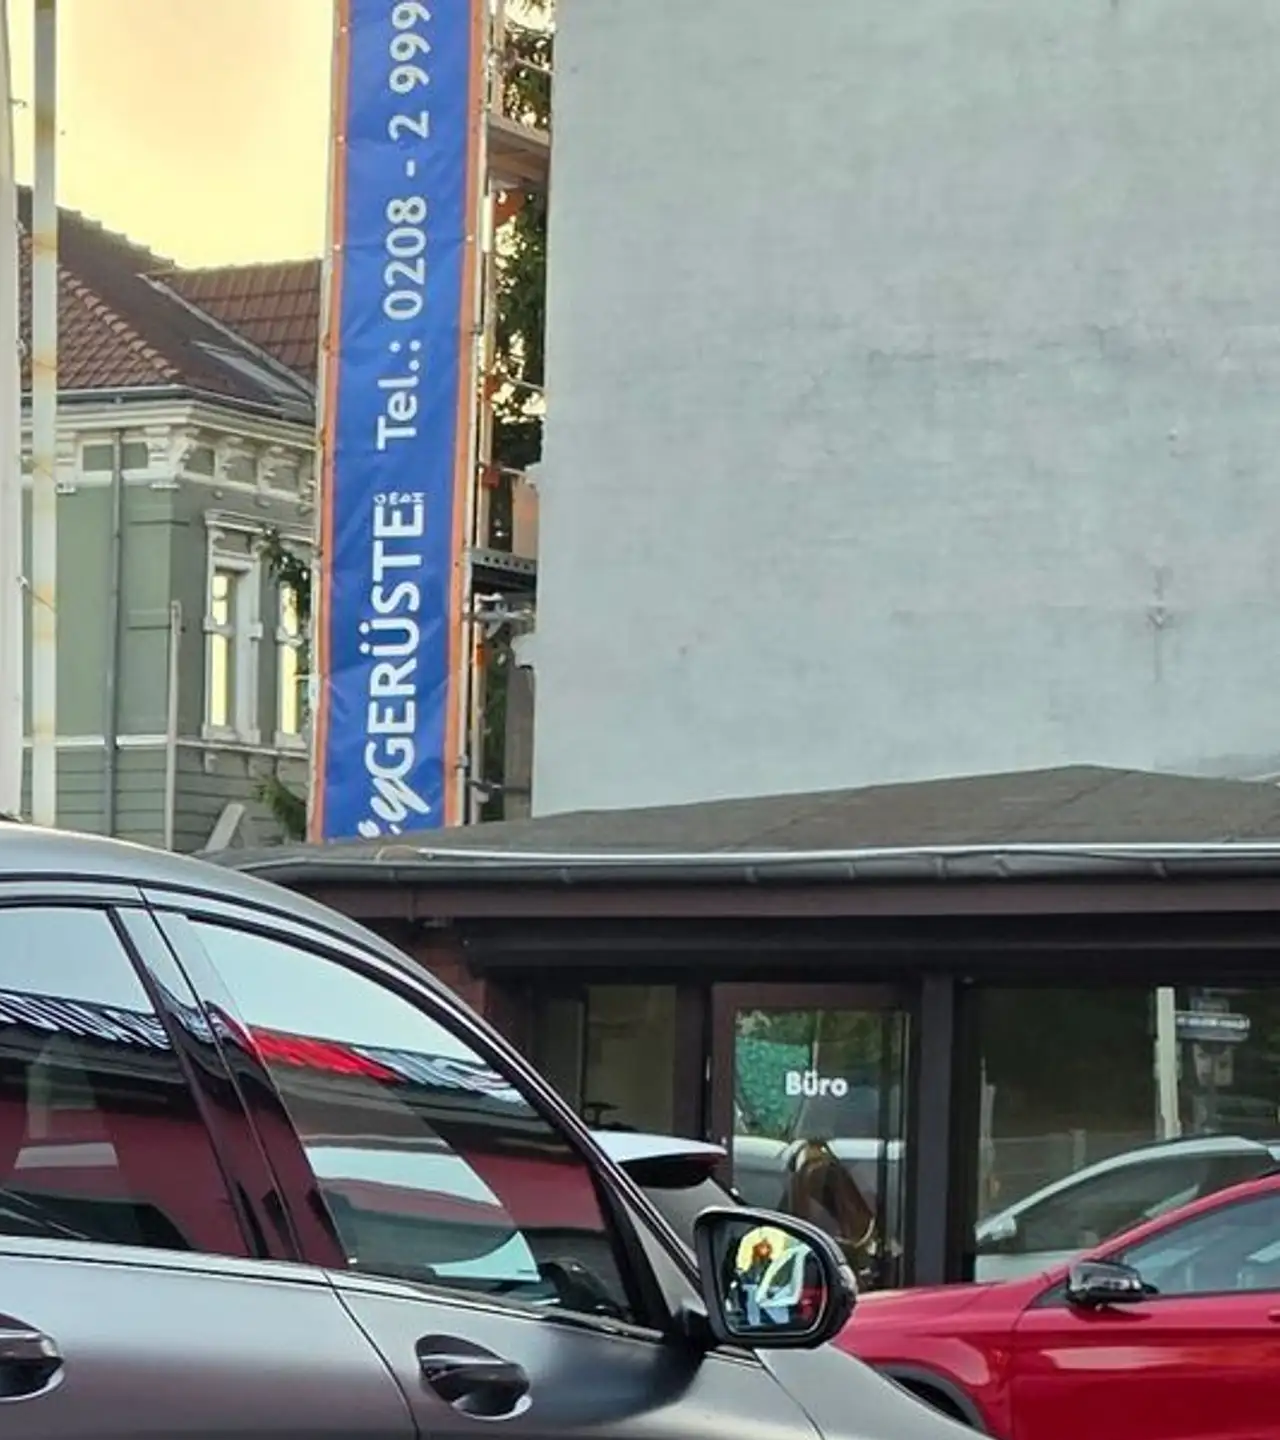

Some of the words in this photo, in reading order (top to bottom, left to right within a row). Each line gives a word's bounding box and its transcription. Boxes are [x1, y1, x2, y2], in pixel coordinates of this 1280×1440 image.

[387, 110, 430, 142] 2
[383, 195, 428, 321] 0208
[376, 339, 422, 451] Tel.:
[785, 1069, 849, 1098] Büro
